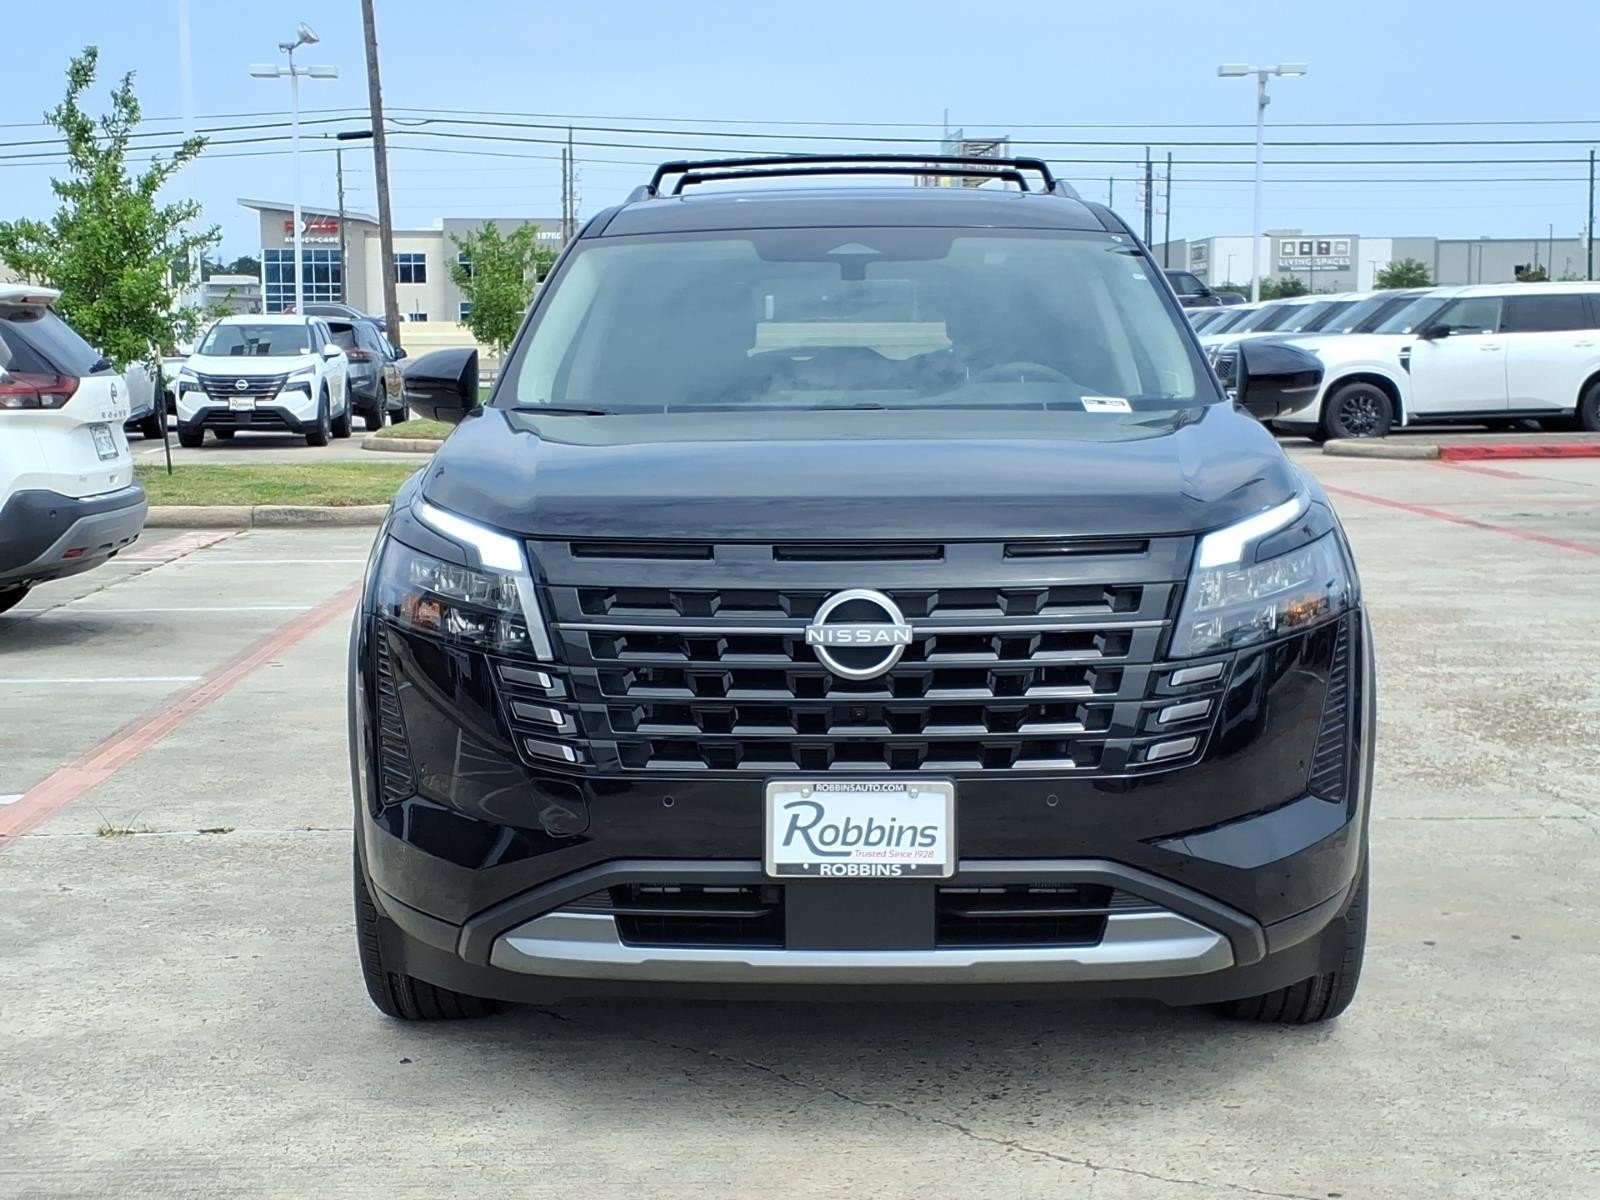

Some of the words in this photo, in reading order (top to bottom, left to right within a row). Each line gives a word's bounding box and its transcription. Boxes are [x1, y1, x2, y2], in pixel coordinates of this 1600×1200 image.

[1279, 258, 1312, 266] LIVING
[1315, 257, 1350, 265] SPACES
[808, 629, 909, 643] NISSAN
[815, 784, 904, 792] ROBBINSAUTO.COM
[781, 800, 939, 857] Robbins
[854, 849, 887, 858] Trusted
[888, 849, 913, 858] Since
[914, 849, 935, 858] 1928
[819, 863, 903, 877] ROBBINS
